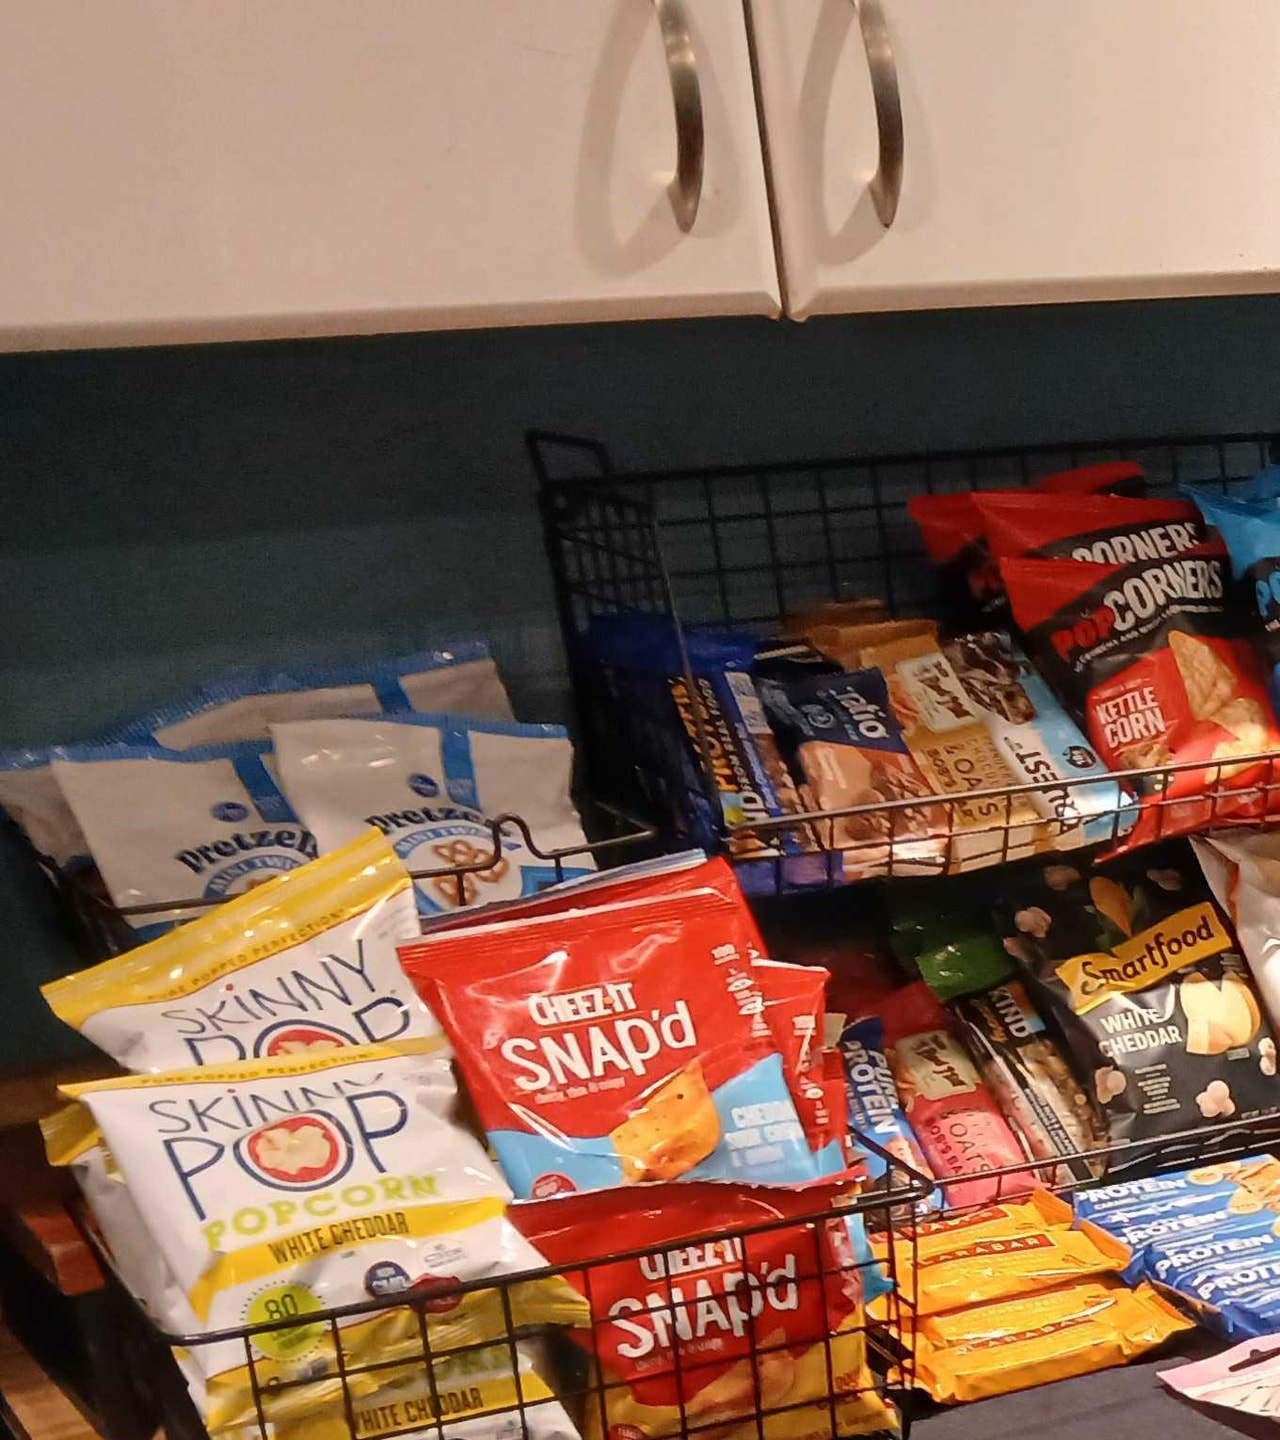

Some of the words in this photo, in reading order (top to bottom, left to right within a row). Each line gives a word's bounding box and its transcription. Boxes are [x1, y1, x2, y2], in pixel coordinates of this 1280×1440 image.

[1095, 686, 1159, 725] KETTLE
[1104, 707, 1165, 749] CORN
[1080, 915, 1215, 996] Smartfood
[1100, 1007, 1161, 1034] WHITE
[1098, 1026, 1183, 1058] CHEDDAR
[843, 1040, 901, 1135] PROTEIN
[163, 1089, 409, 1221] POP
[947, 1154, 964, 1176] BA
[1076, 1178, 1188, 1202] PROTEIN
[201, 1174, 440, 1252] POPCORN
[267, 1226, 331, 1265] WHITE
[331, 1211, 410, 1247] CHEDDAR
[917, 1236, 1041, 1268] LARABAR
[1155, 1234, 1274, 1280] PROTEIN
[264, 1293, 299, 1321] 80
